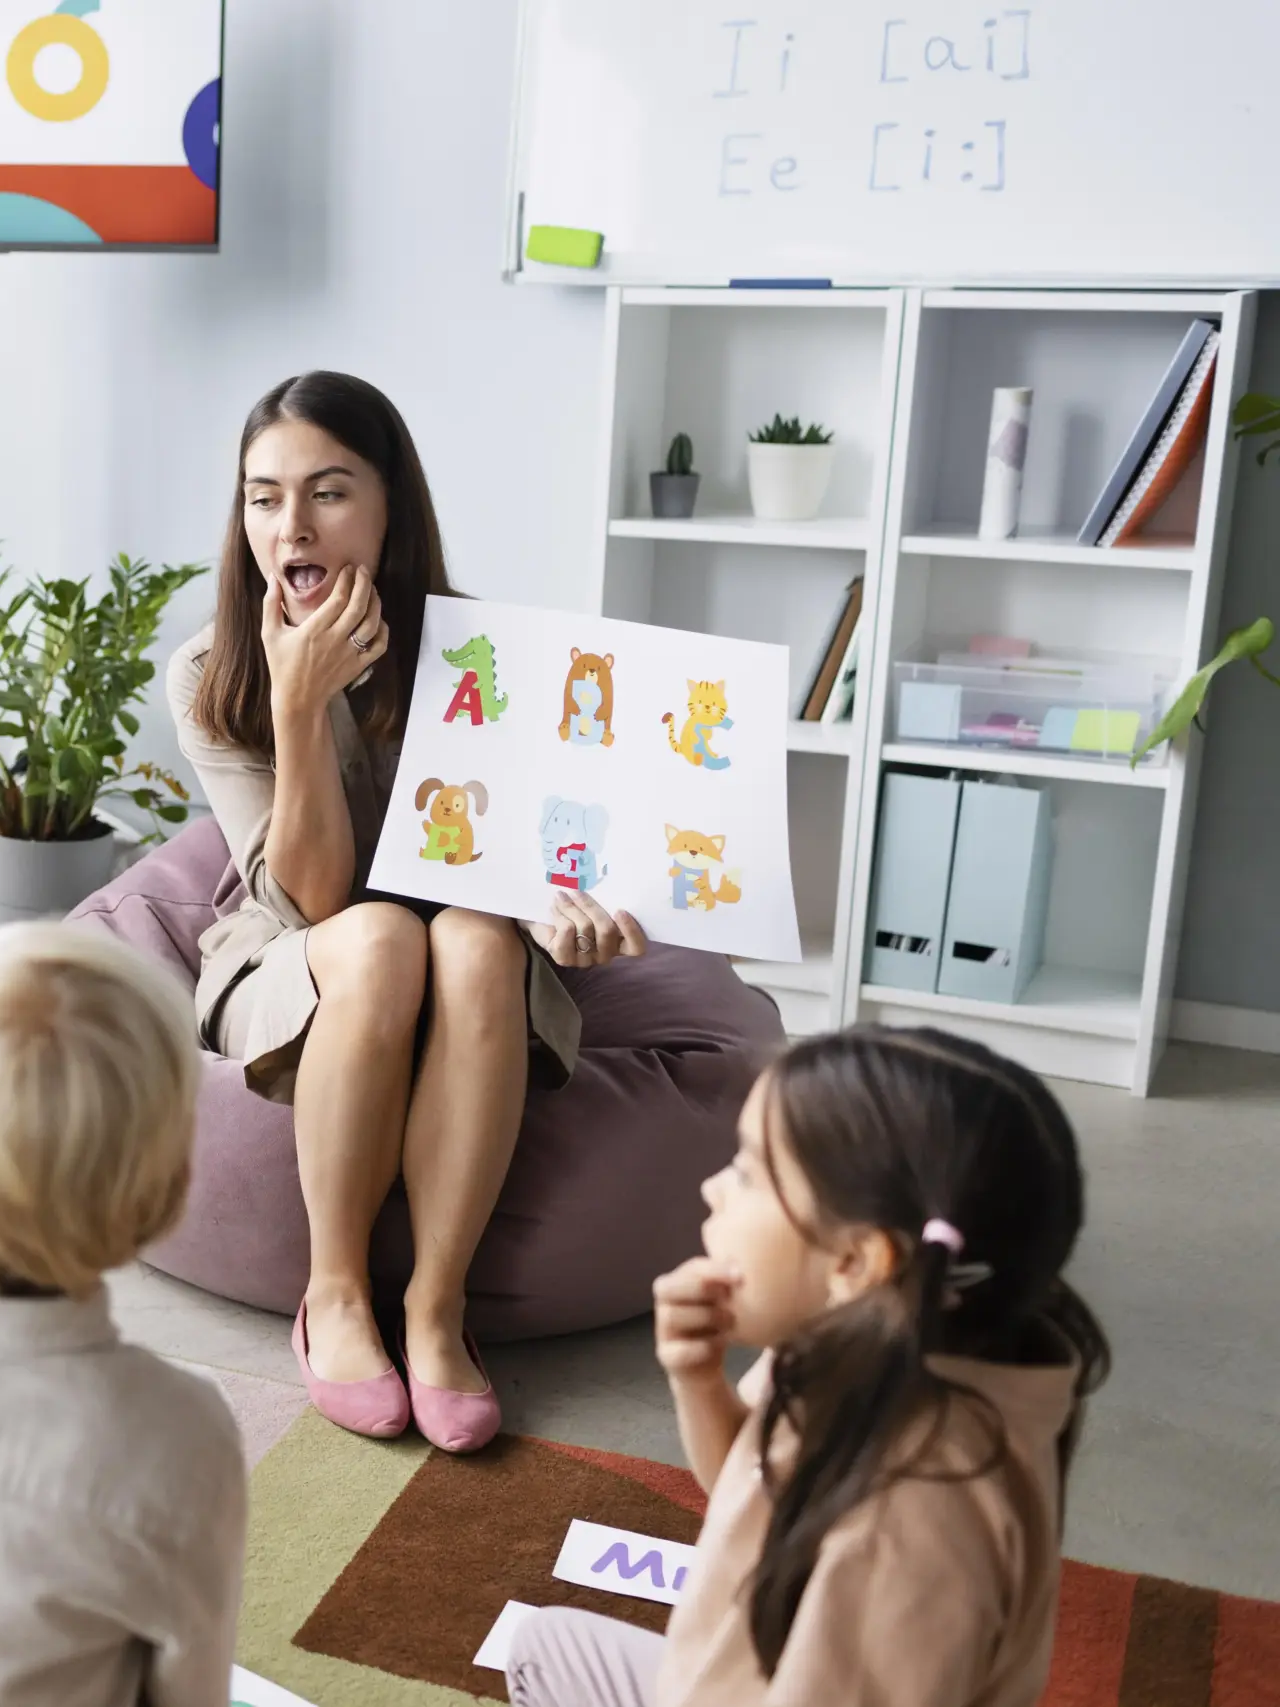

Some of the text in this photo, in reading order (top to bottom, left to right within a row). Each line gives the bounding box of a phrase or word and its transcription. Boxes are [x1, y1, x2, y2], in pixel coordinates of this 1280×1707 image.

[442, 671, 484, 726] A
[672, 857, 705, 911] F
[590, 1542, 688, 1591] M
